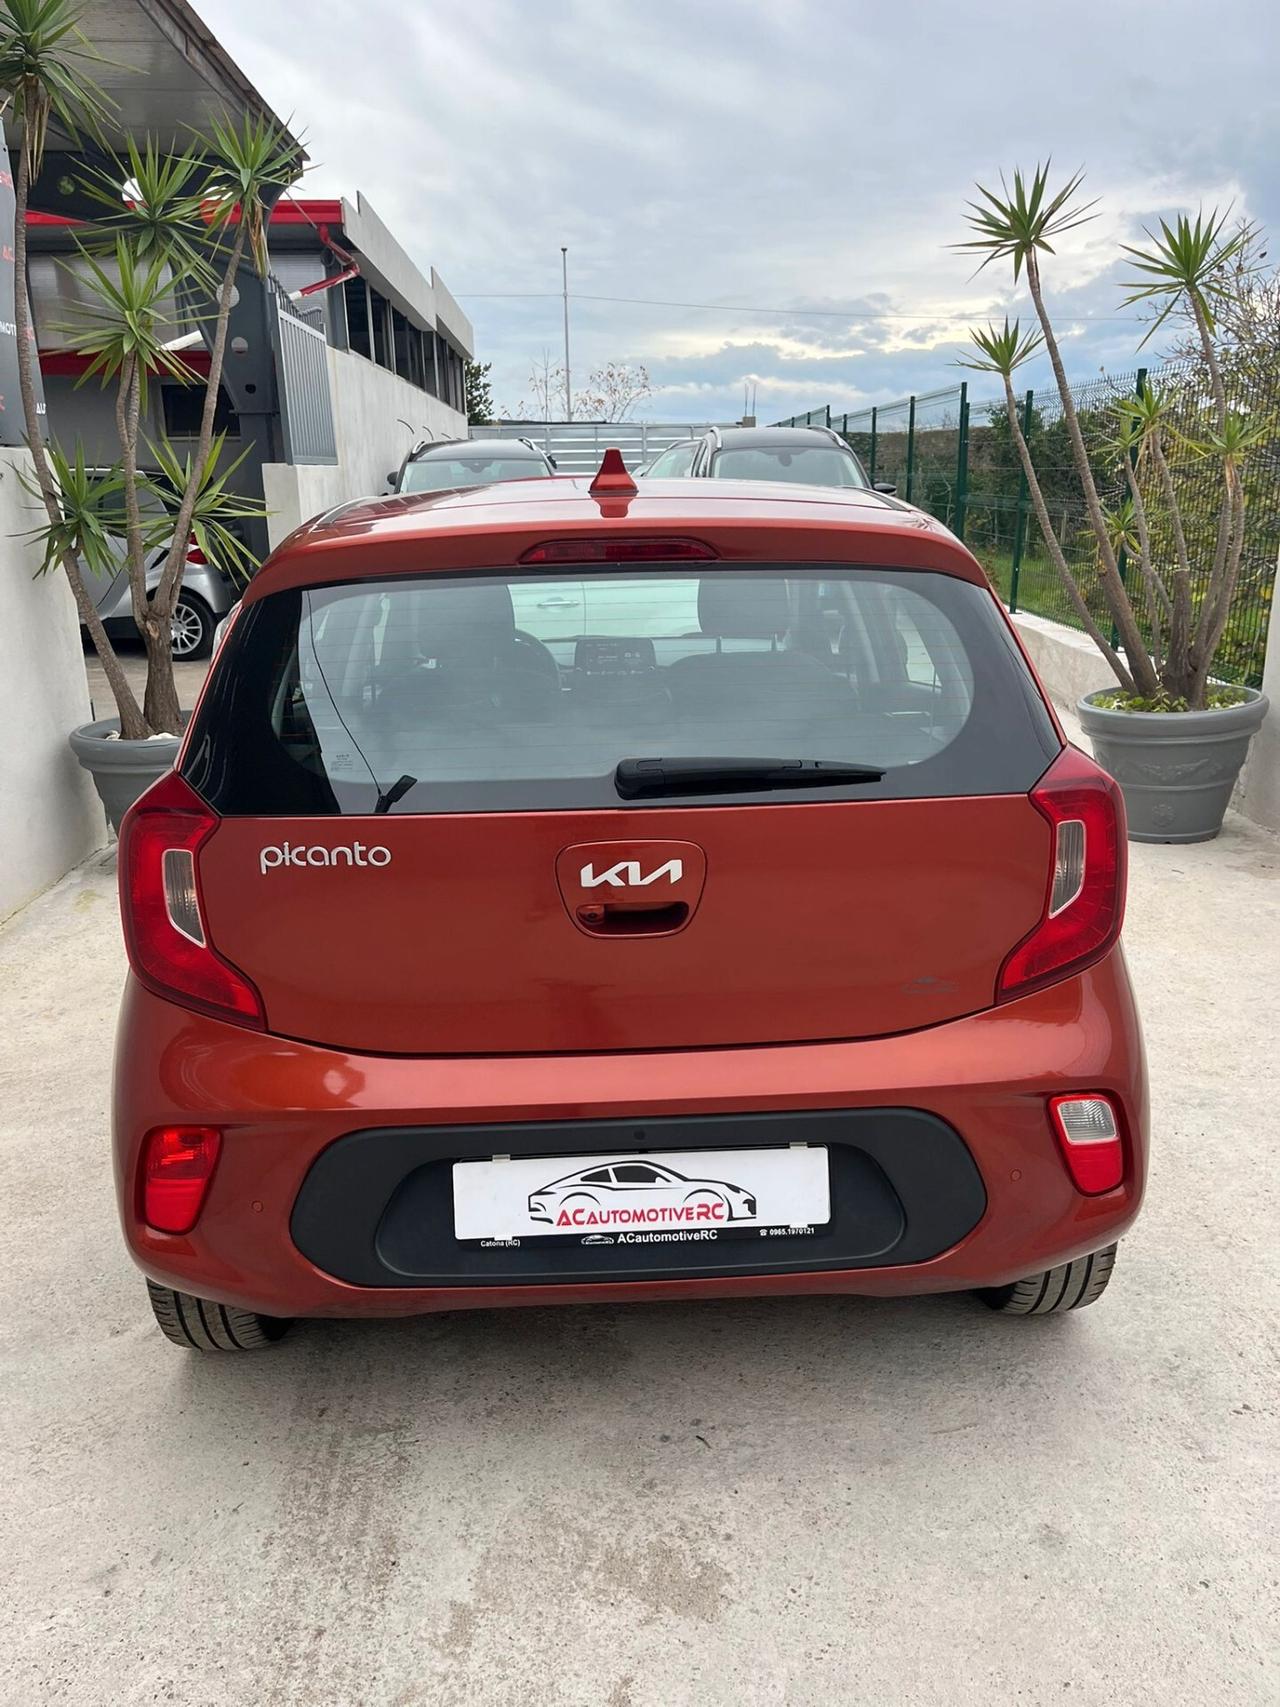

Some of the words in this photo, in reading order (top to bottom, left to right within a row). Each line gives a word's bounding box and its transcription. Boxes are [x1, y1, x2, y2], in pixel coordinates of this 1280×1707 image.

[260, 841, 392, 875] picanto
[580, 859, 683, 887] KIA
[617, 1229, 718, 1244] ACautomotiveRC
